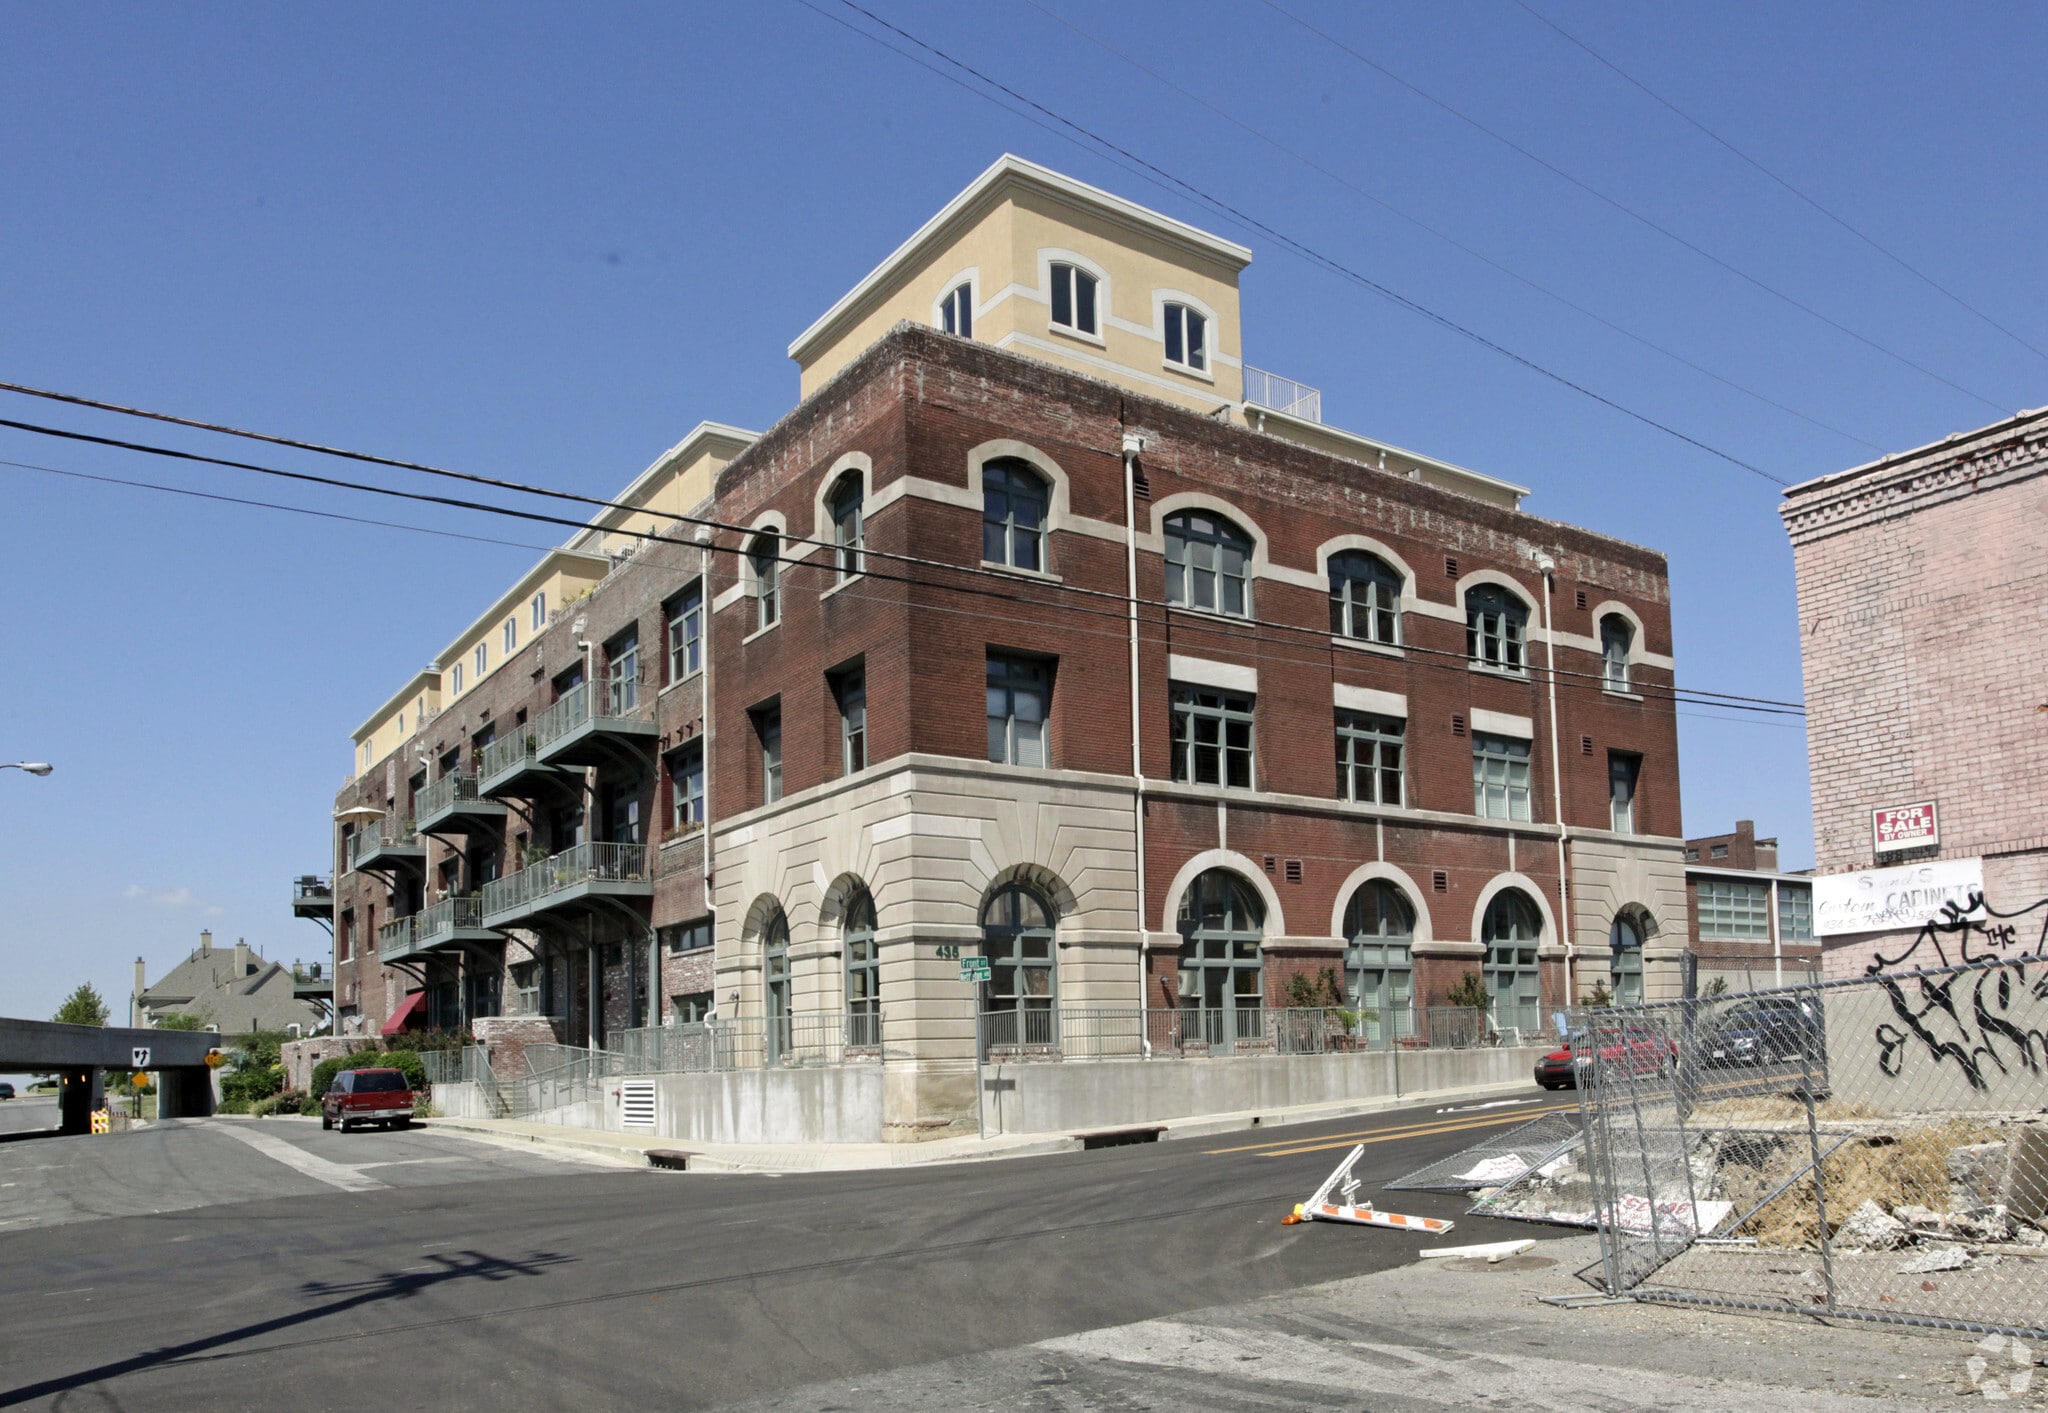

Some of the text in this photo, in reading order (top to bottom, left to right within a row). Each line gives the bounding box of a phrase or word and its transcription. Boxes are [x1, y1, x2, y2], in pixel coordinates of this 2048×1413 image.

[1886, 808, 1923, 821] FOR
[1880, 816, 1932, 833] SALE
[1884, 829, 1928, 840] BY OWNER
[962, 959, 979, 968] Front
